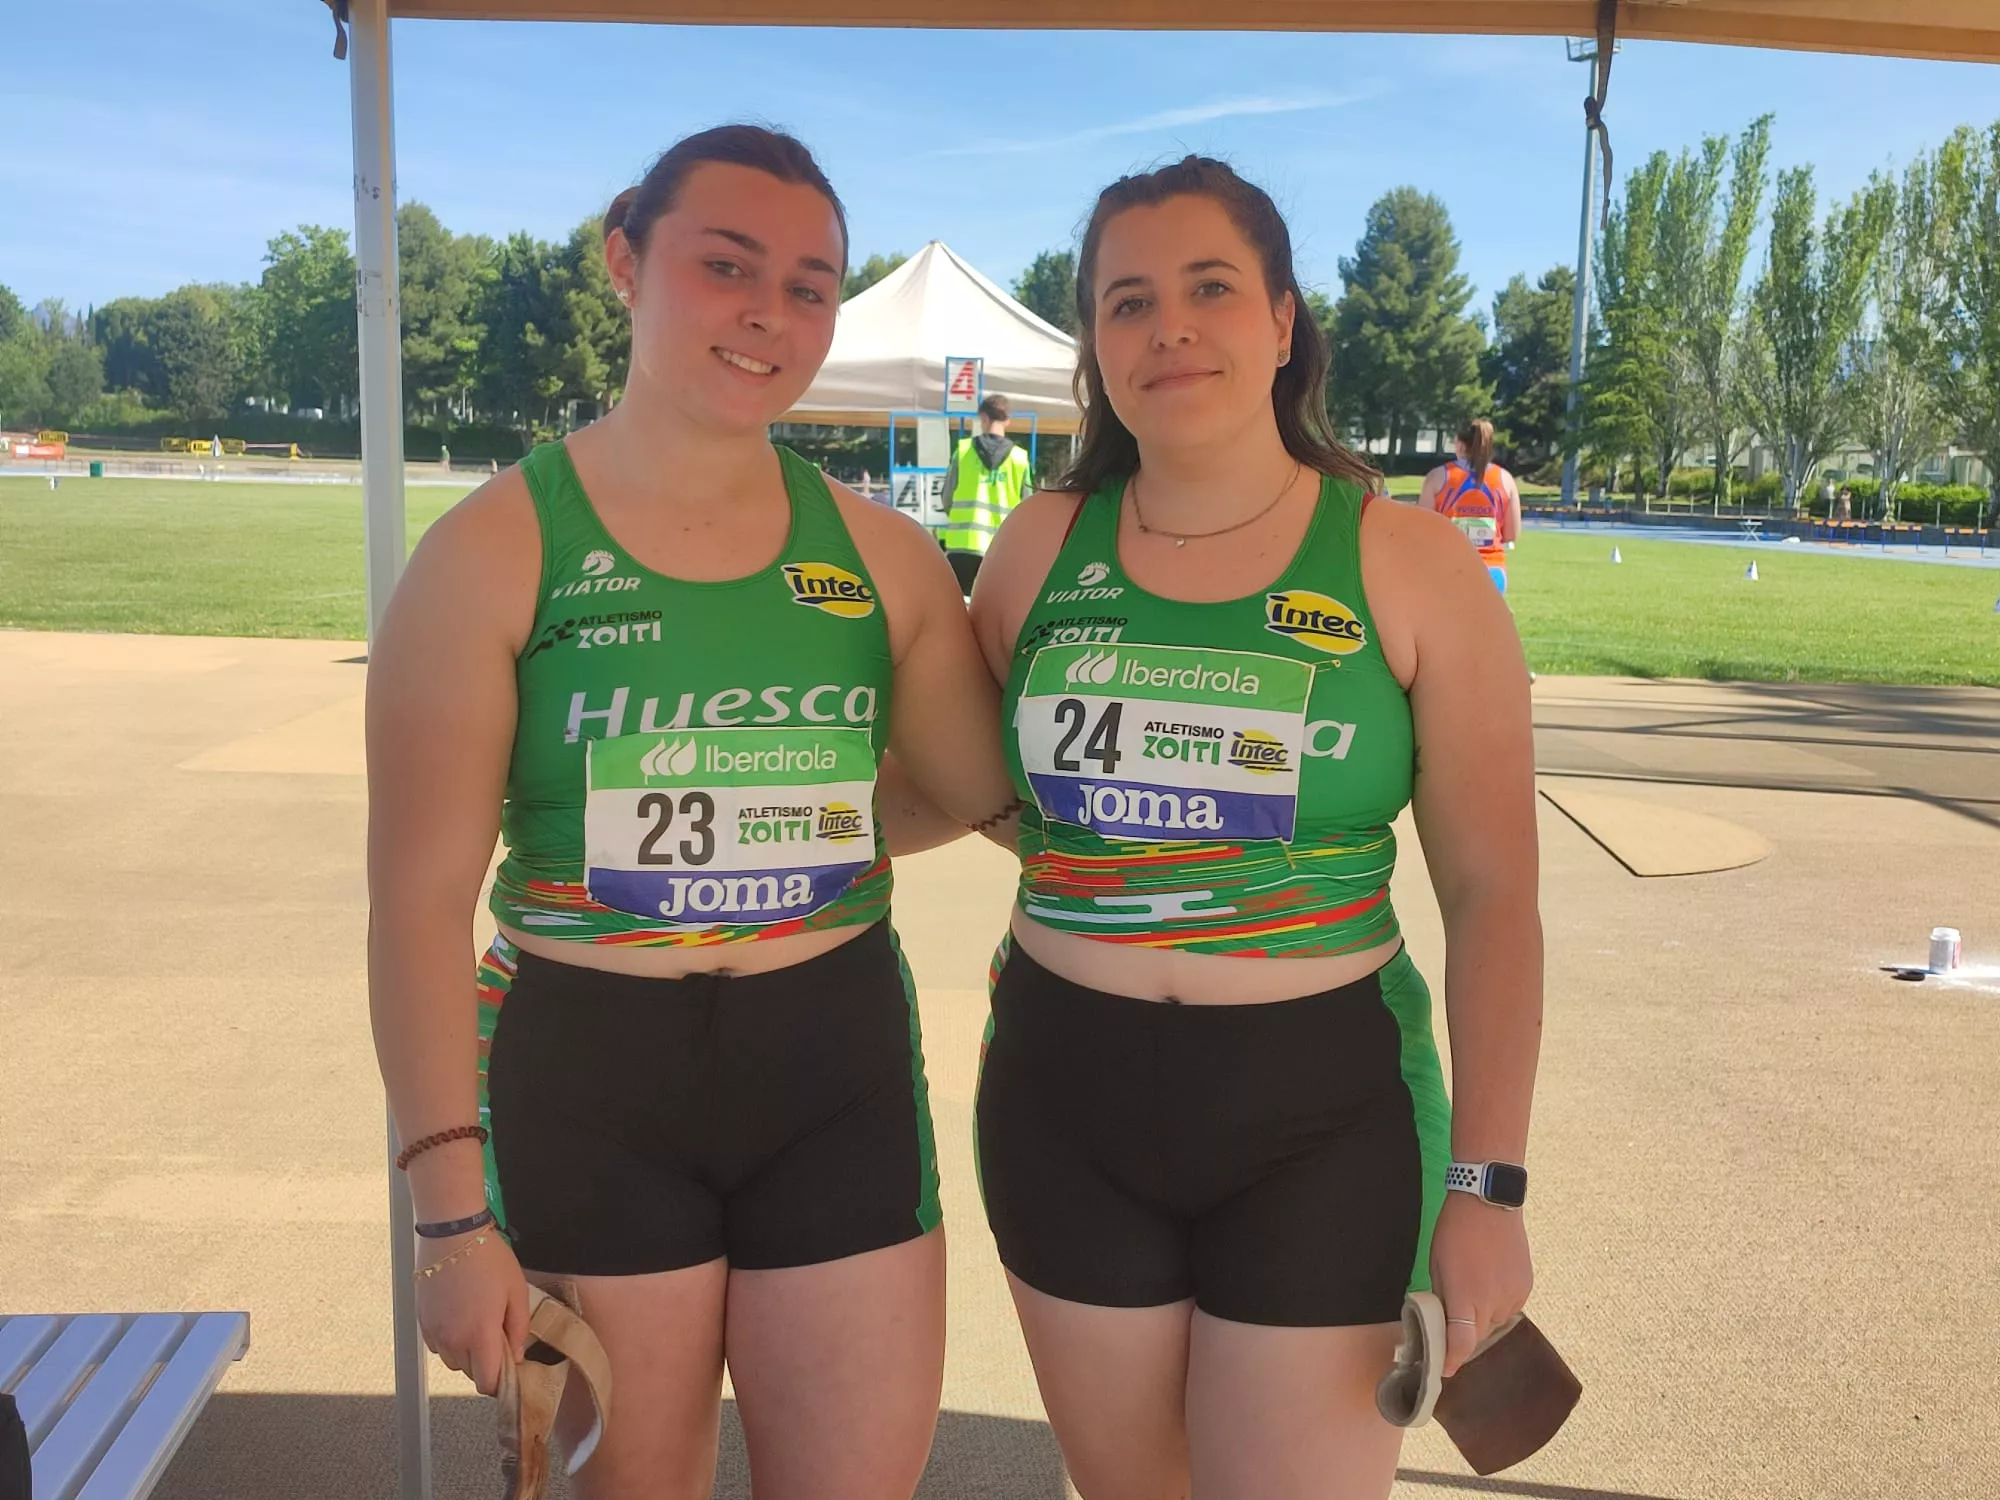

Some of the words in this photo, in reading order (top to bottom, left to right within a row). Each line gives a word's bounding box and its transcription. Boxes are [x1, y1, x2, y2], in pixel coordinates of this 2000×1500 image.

[950, 361, 975, 400] 4
[551, 577, 642, 600] VIATOR
[1046, 587, 1125, 604] VIATOR
[578, 610, 663, 626] ATLETISMO
[1054, 616, 1128, 627] ATLETISMO
[576, 621, 661, 649] ZOITI
[1048, 626, 1124, 645] ZOITI
[1121, 658, 1260, 695] Iberdrola
[564, 684, 877, 744] Huesca
[1053, 698, 1124, 774] 24
[1144, 721, 1224, 740] ATLETISMO
[704, 743, 838, 774] Iberdrola
[1142, 735, 1221, 765] ZOITI
[738, 806, 813, 819] ATLETISMO
[637, 791, 716, 866] 23
[738, 820, 811, 845] ZOITI
